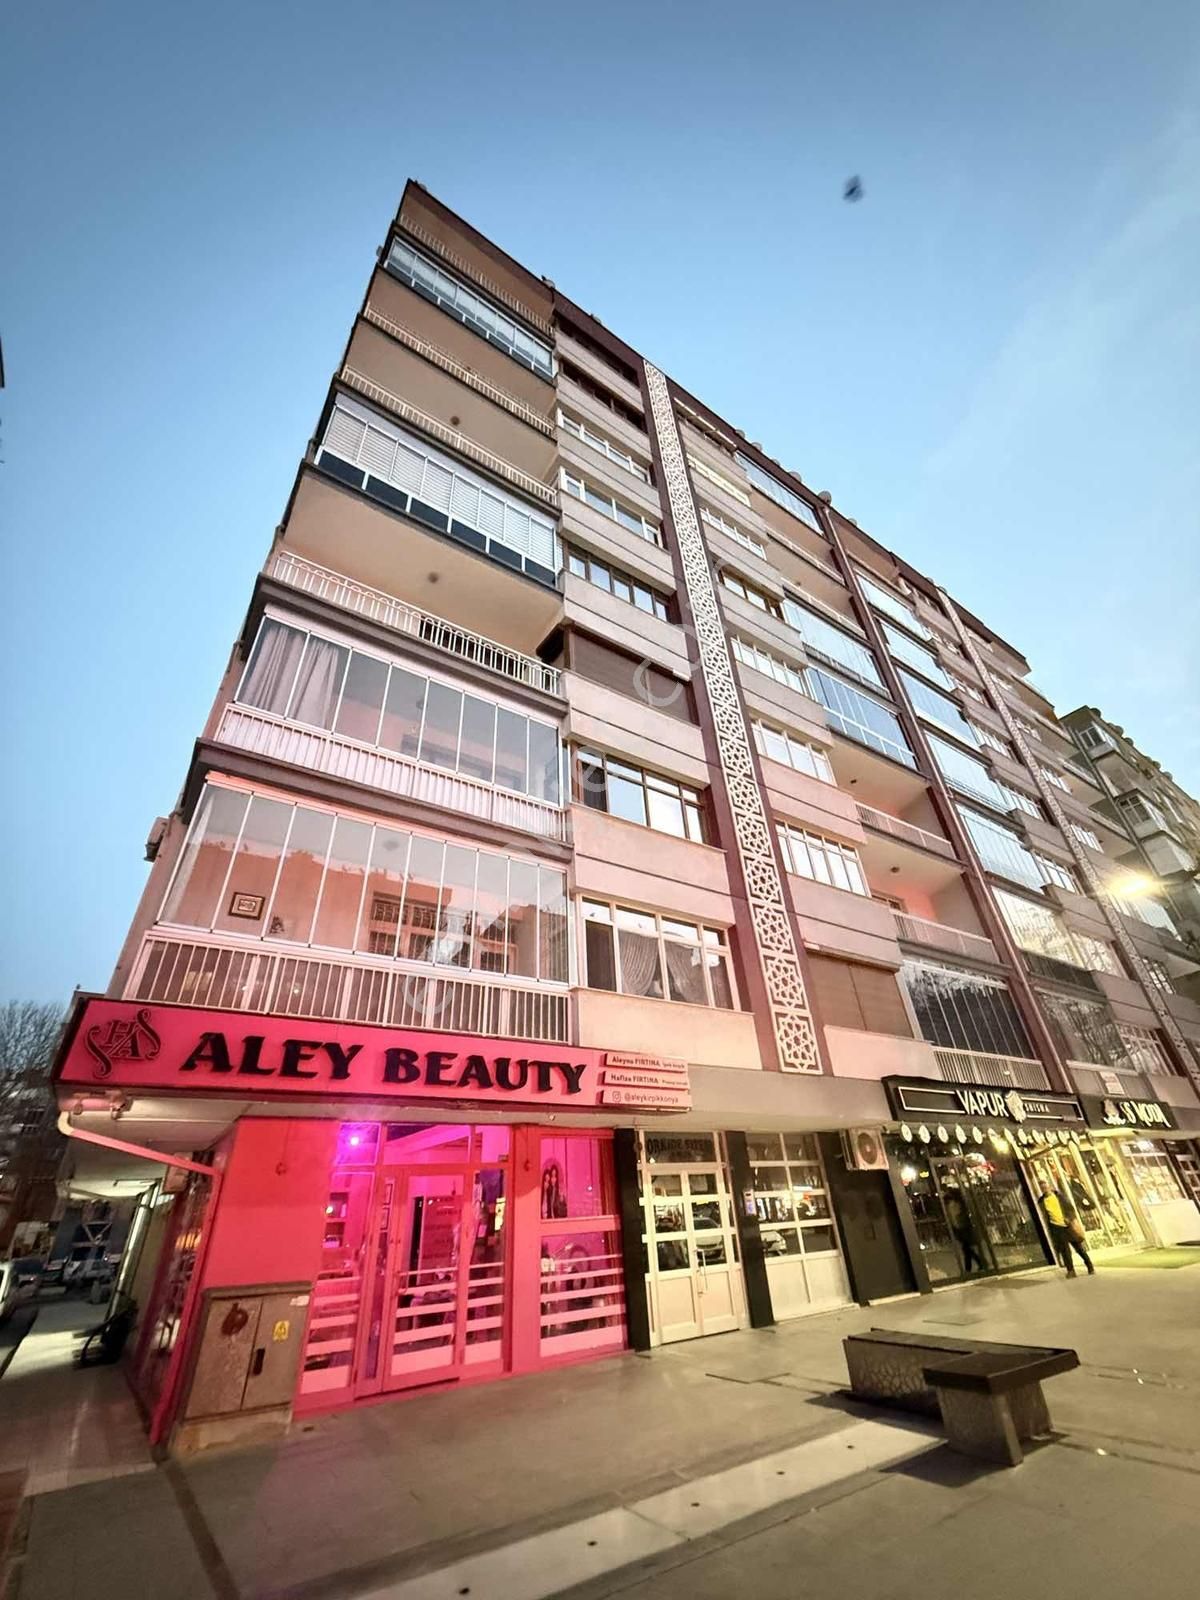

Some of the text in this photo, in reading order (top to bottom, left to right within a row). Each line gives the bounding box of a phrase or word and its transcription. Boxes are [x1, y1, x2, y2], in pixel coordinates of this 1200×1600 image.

[179, 1031, 588, 1095] ALEY BEAUTY
[955, 1089, 1010, 1117] VAPUR
